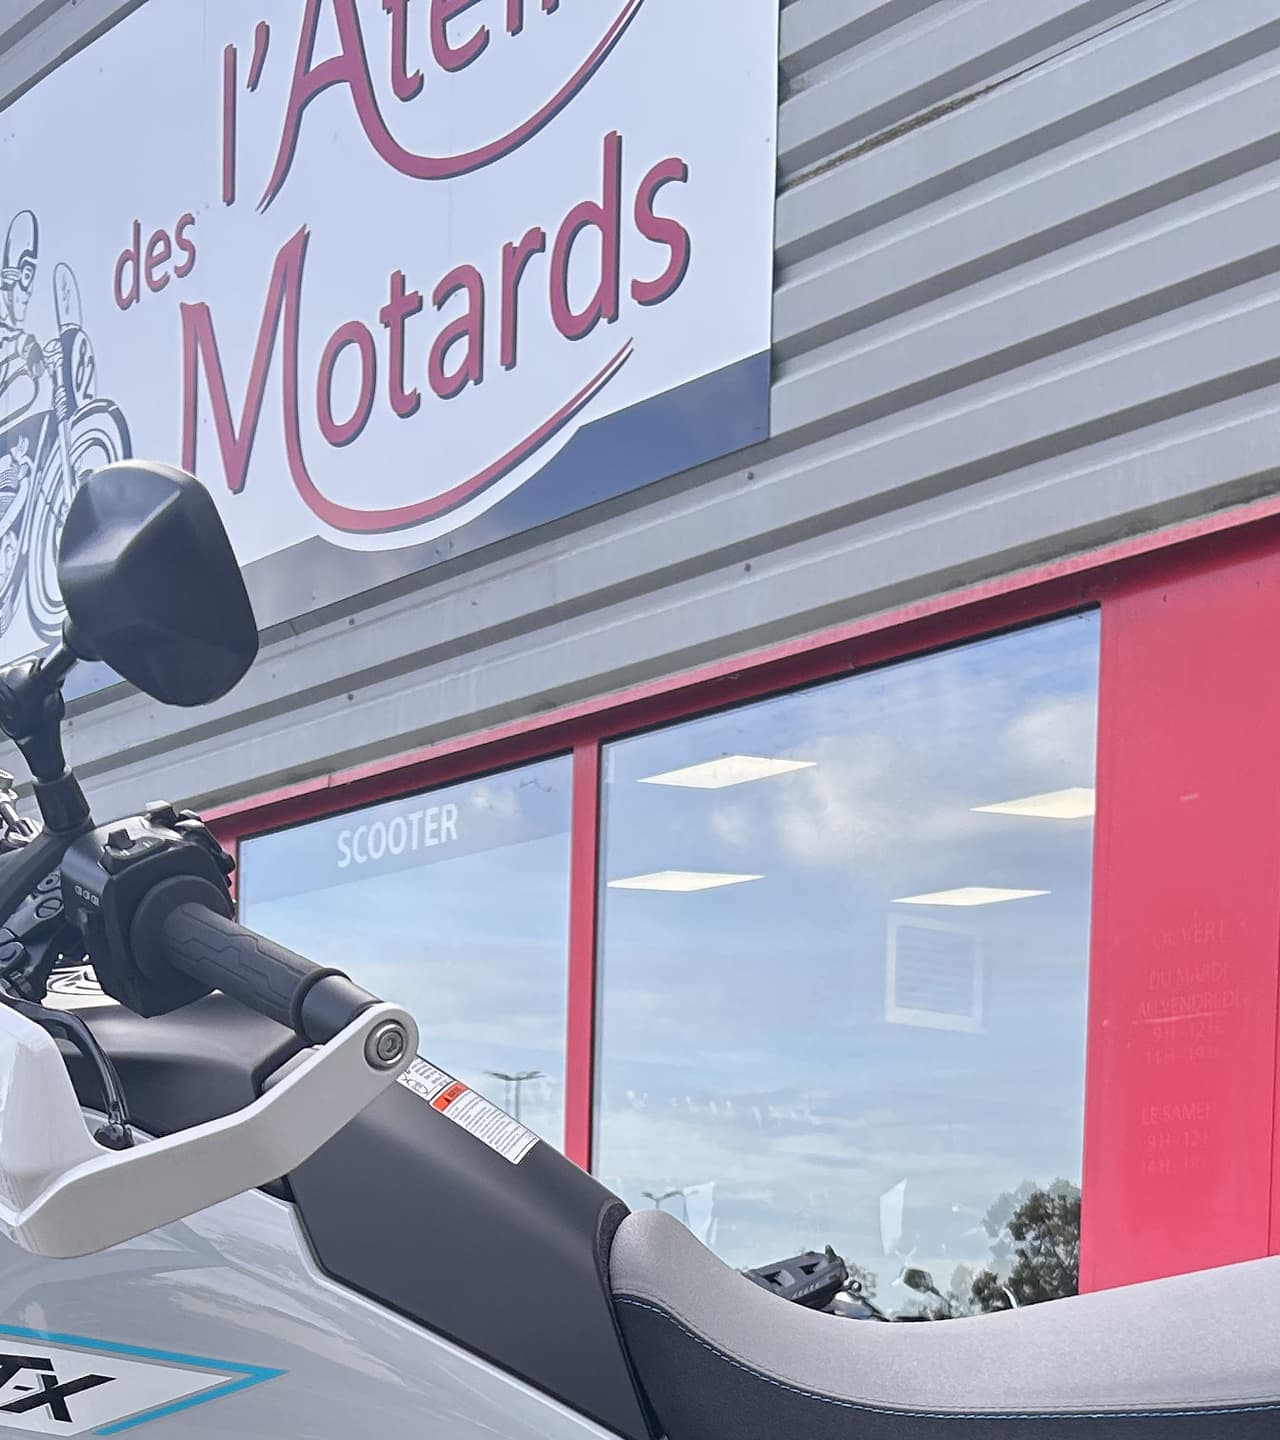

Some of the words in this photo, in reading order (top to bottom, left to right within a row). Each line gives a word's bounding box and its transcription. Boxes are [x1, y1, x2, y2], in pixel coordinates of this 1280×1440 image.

[113, 212, 198, 312] des
[179, 130, 689, 533] Motards
[336, 803, 459, 868] SCOOTER
